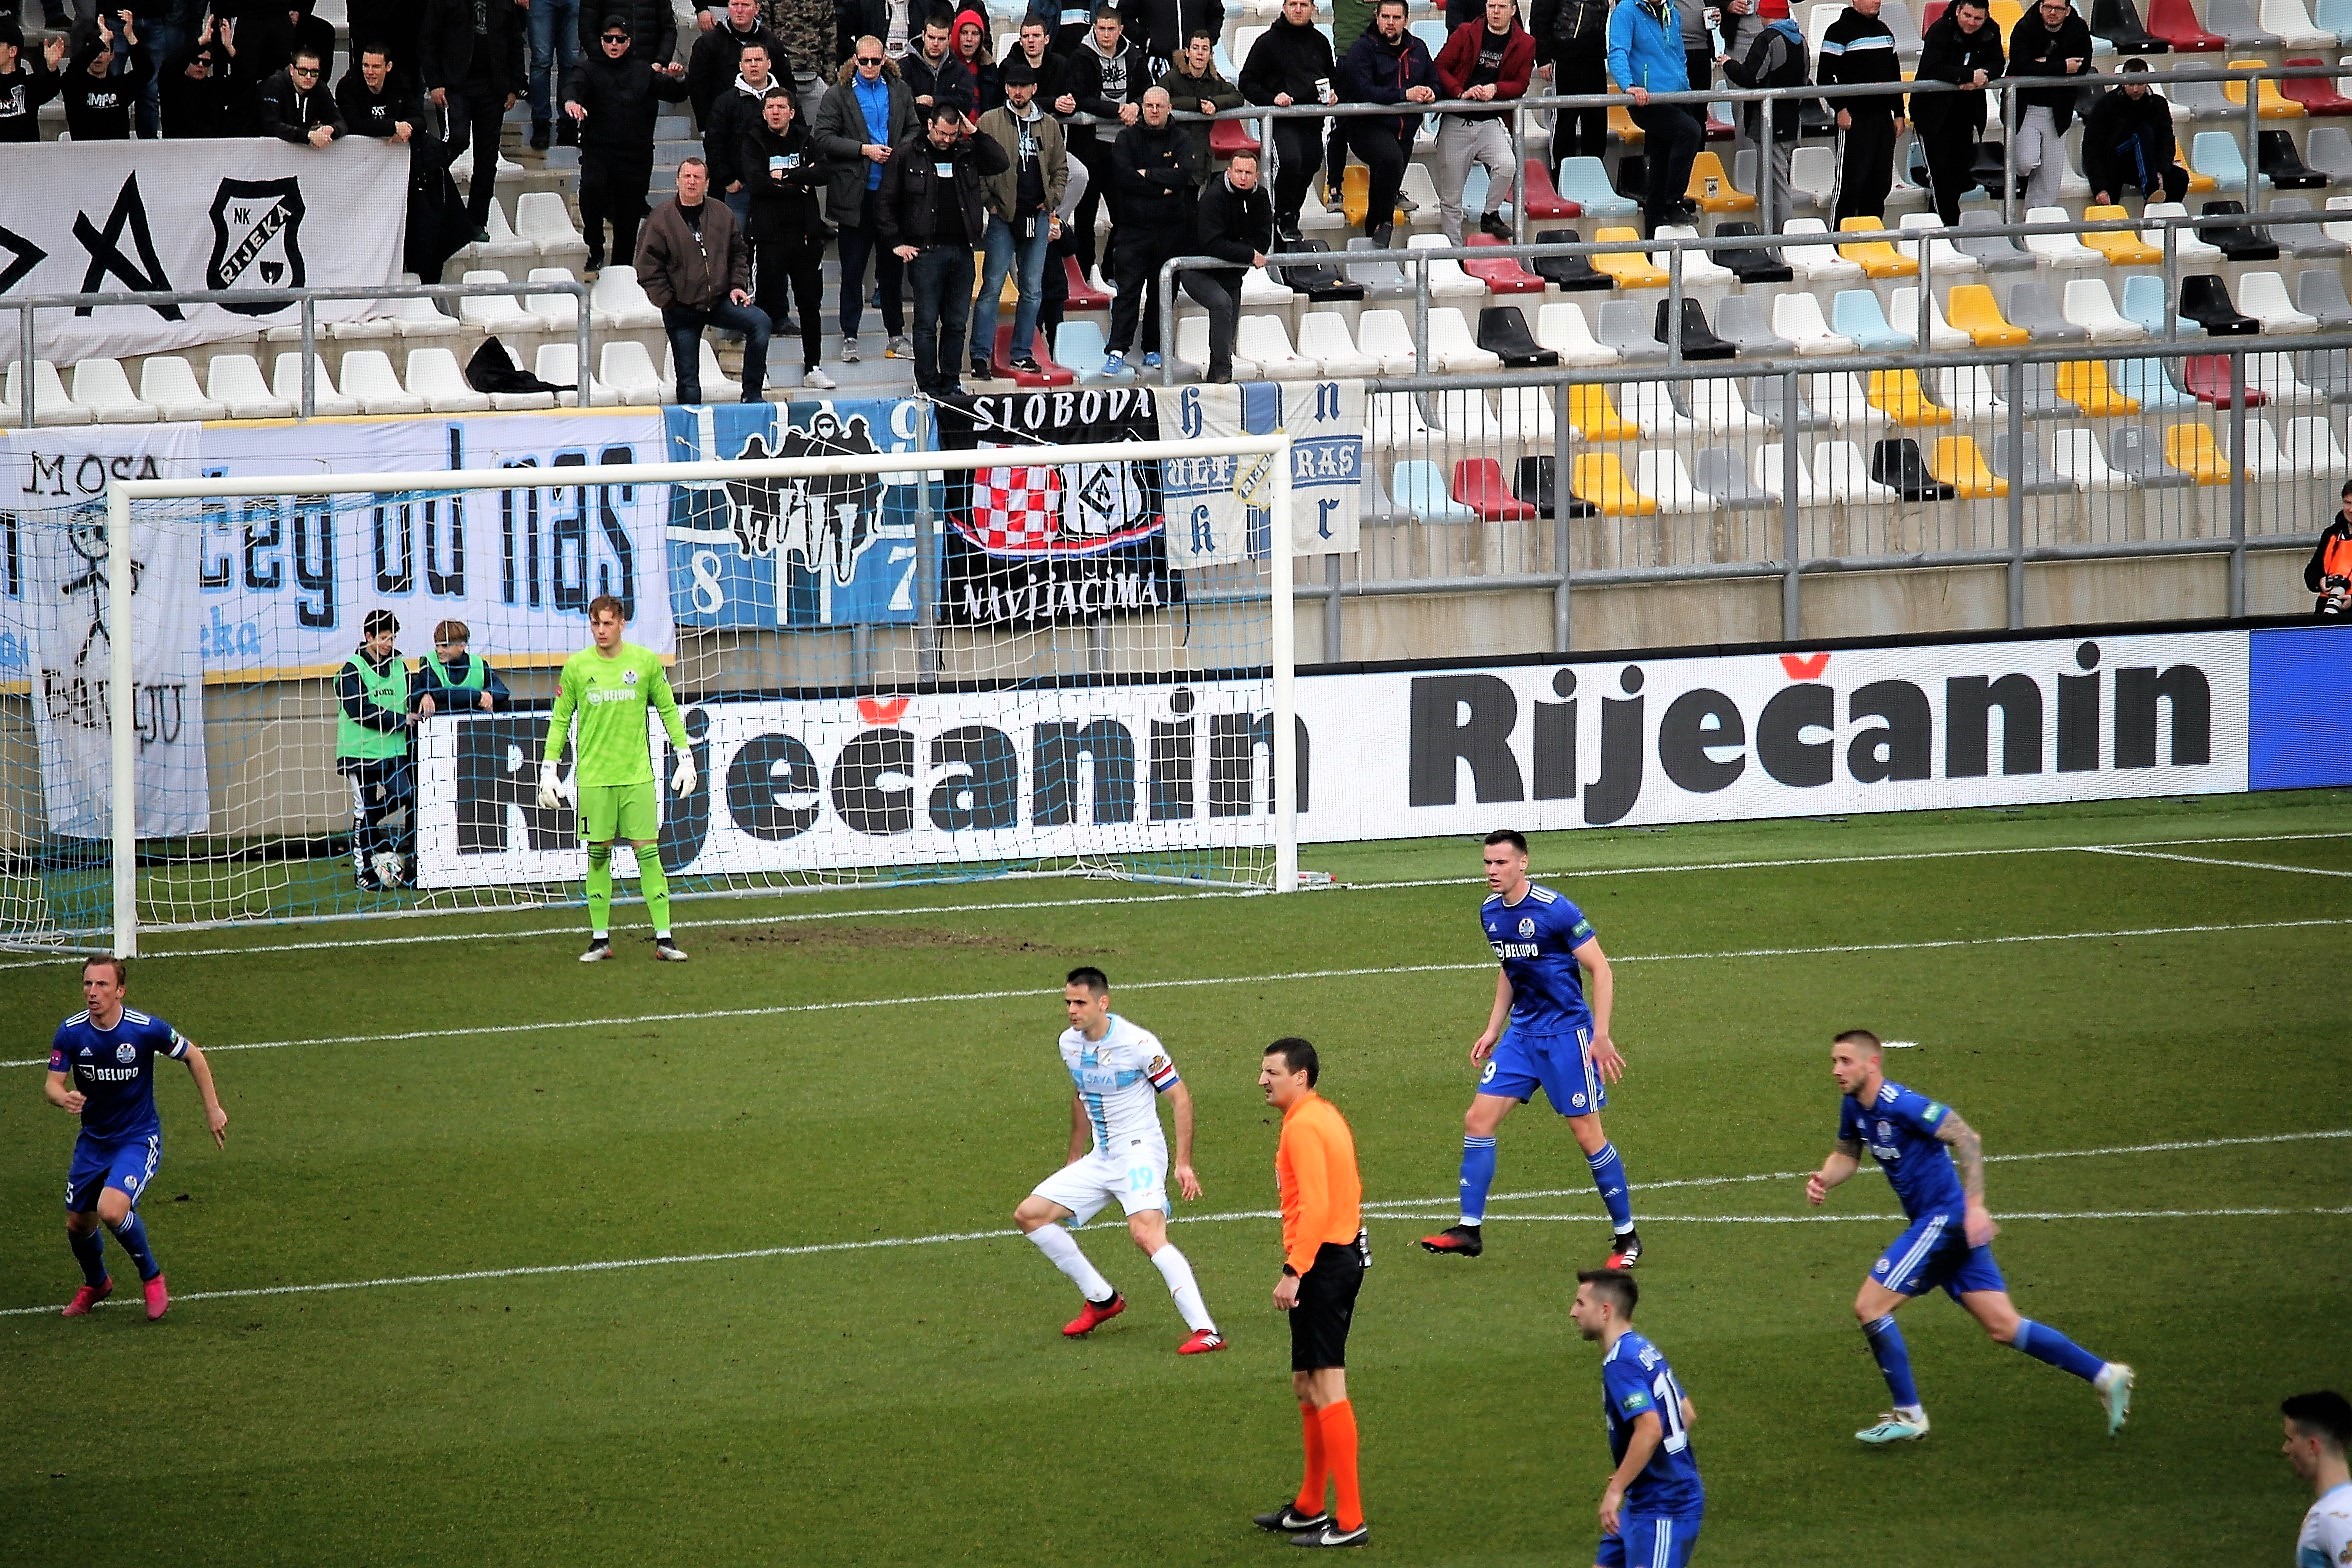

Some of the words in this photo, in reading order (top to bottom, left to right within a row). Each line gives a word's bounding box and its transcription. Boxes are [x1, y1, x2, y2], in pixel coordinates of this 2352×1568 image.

[233, 207, 251, 225] NK
[220, 203, 292, 285] RIJEKA
[972, 387, 1152, 433] SLOBODA
[603, 689, 636, 701] BELUPO
[1409, 640, 2210, 825] Riječanin
[457, 686, 1310, 873] Rječanin
[580, 816, 591, 835] 1
[1505, 943, 1539, 959] BELUPO
[97, 1066, 139, 1081] BELUPO
[1128, 1166, 1154, 1192] 19
